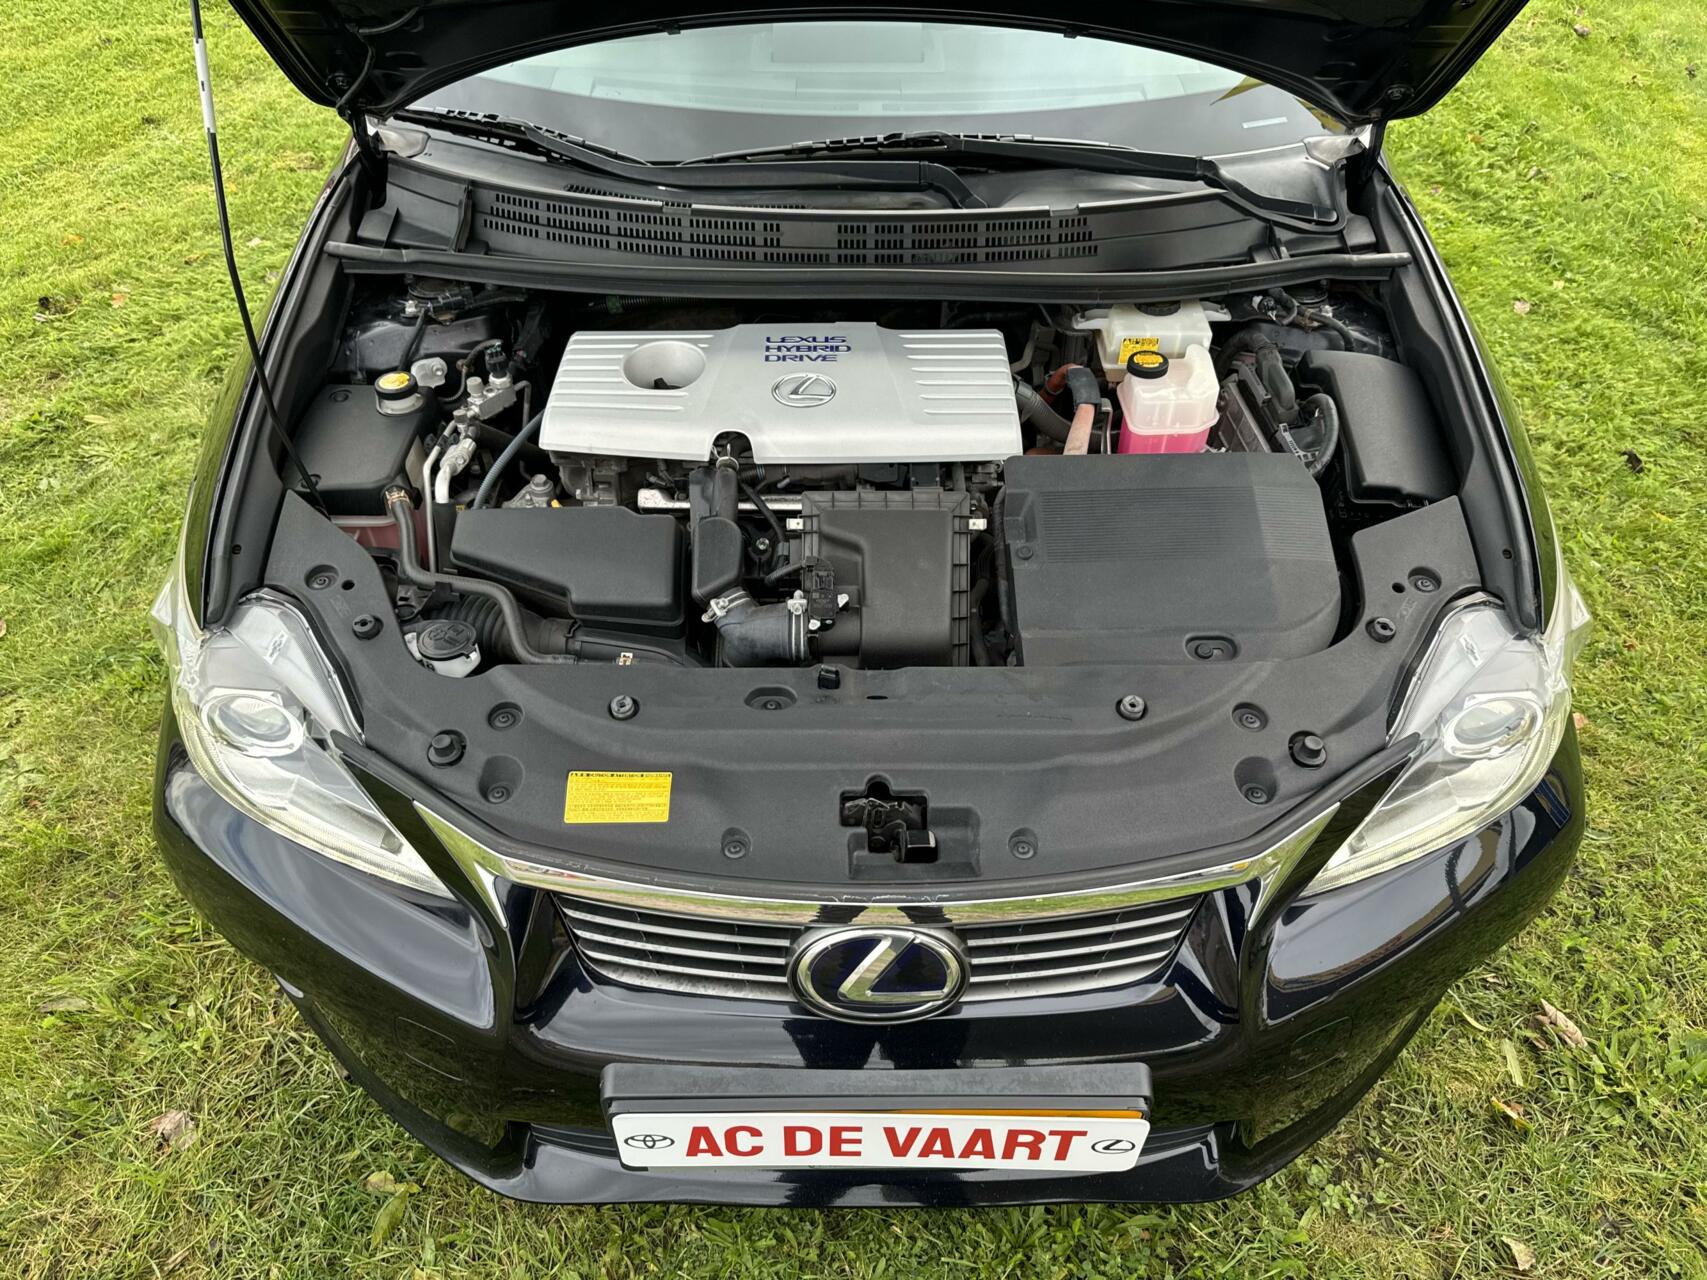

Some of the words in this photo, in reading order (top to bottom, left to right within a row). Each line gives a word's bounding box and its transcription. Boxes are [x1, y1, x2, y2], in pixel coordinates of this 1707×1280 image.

[764, 354, 838, 362] DRIVE
[686, 1126, 764, 1157] AC
[783, 1126, 862, 1157] DE
[883, 1127, 1088, 1161] VAART
